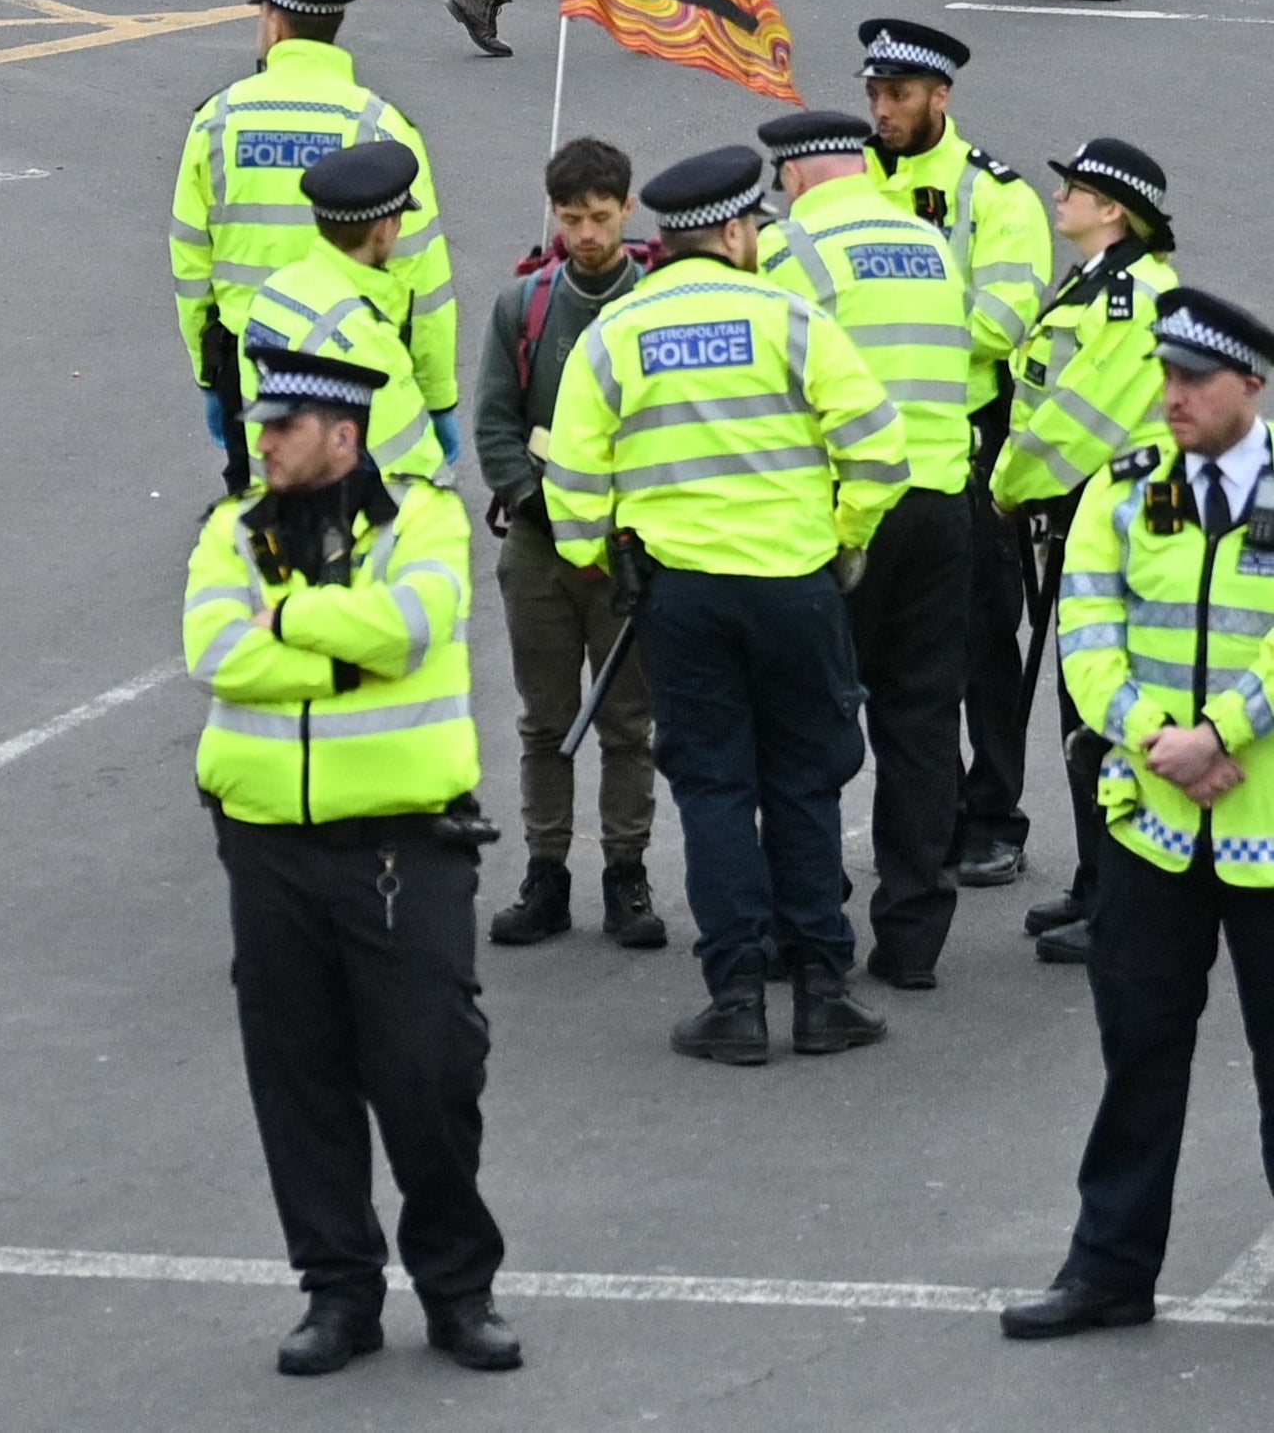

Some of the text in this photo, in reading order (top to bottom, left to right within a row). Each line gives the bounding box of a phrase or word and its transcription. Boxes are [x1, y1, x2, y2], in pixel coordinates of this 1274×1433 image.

[239, 131, 341, 145] METROPOLITAN
[847, 244, 938, 258] METROPOLITAN
[855, 256, 944, 278] POLICE
[642, 323, 747, 345] METROPOLITAN
[643, 337, 749, 371] POLICE
